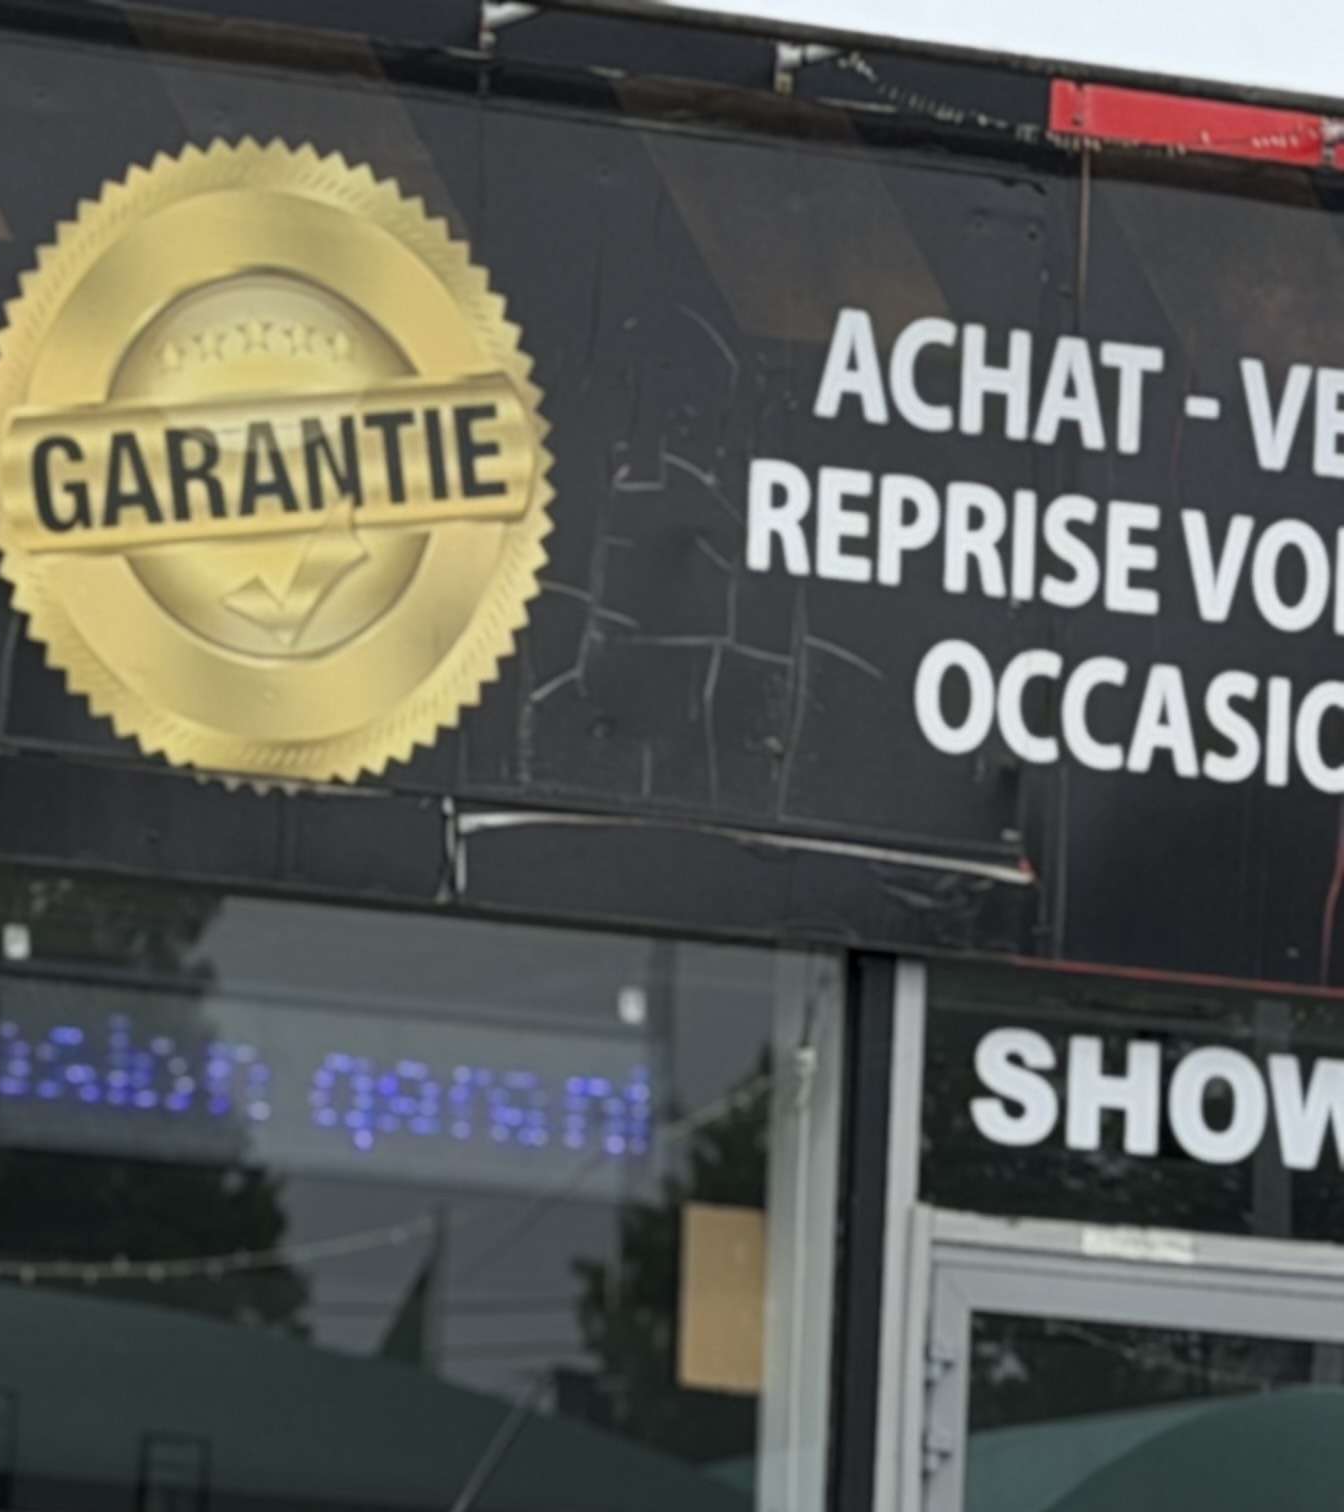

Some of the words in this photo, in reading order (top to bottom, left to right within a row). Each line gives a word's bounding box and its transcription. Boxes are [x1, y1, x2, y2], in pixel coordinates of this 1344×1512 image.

[813, 307, 1164, 455] ACHAT
[30, 404, 507, 533] GARANTIE
[746, 457, 1160, 616] REPRISE
[914, 639, 1344, 796] OCCASIO
[969, 1028, 1344, 1171] SHOW
